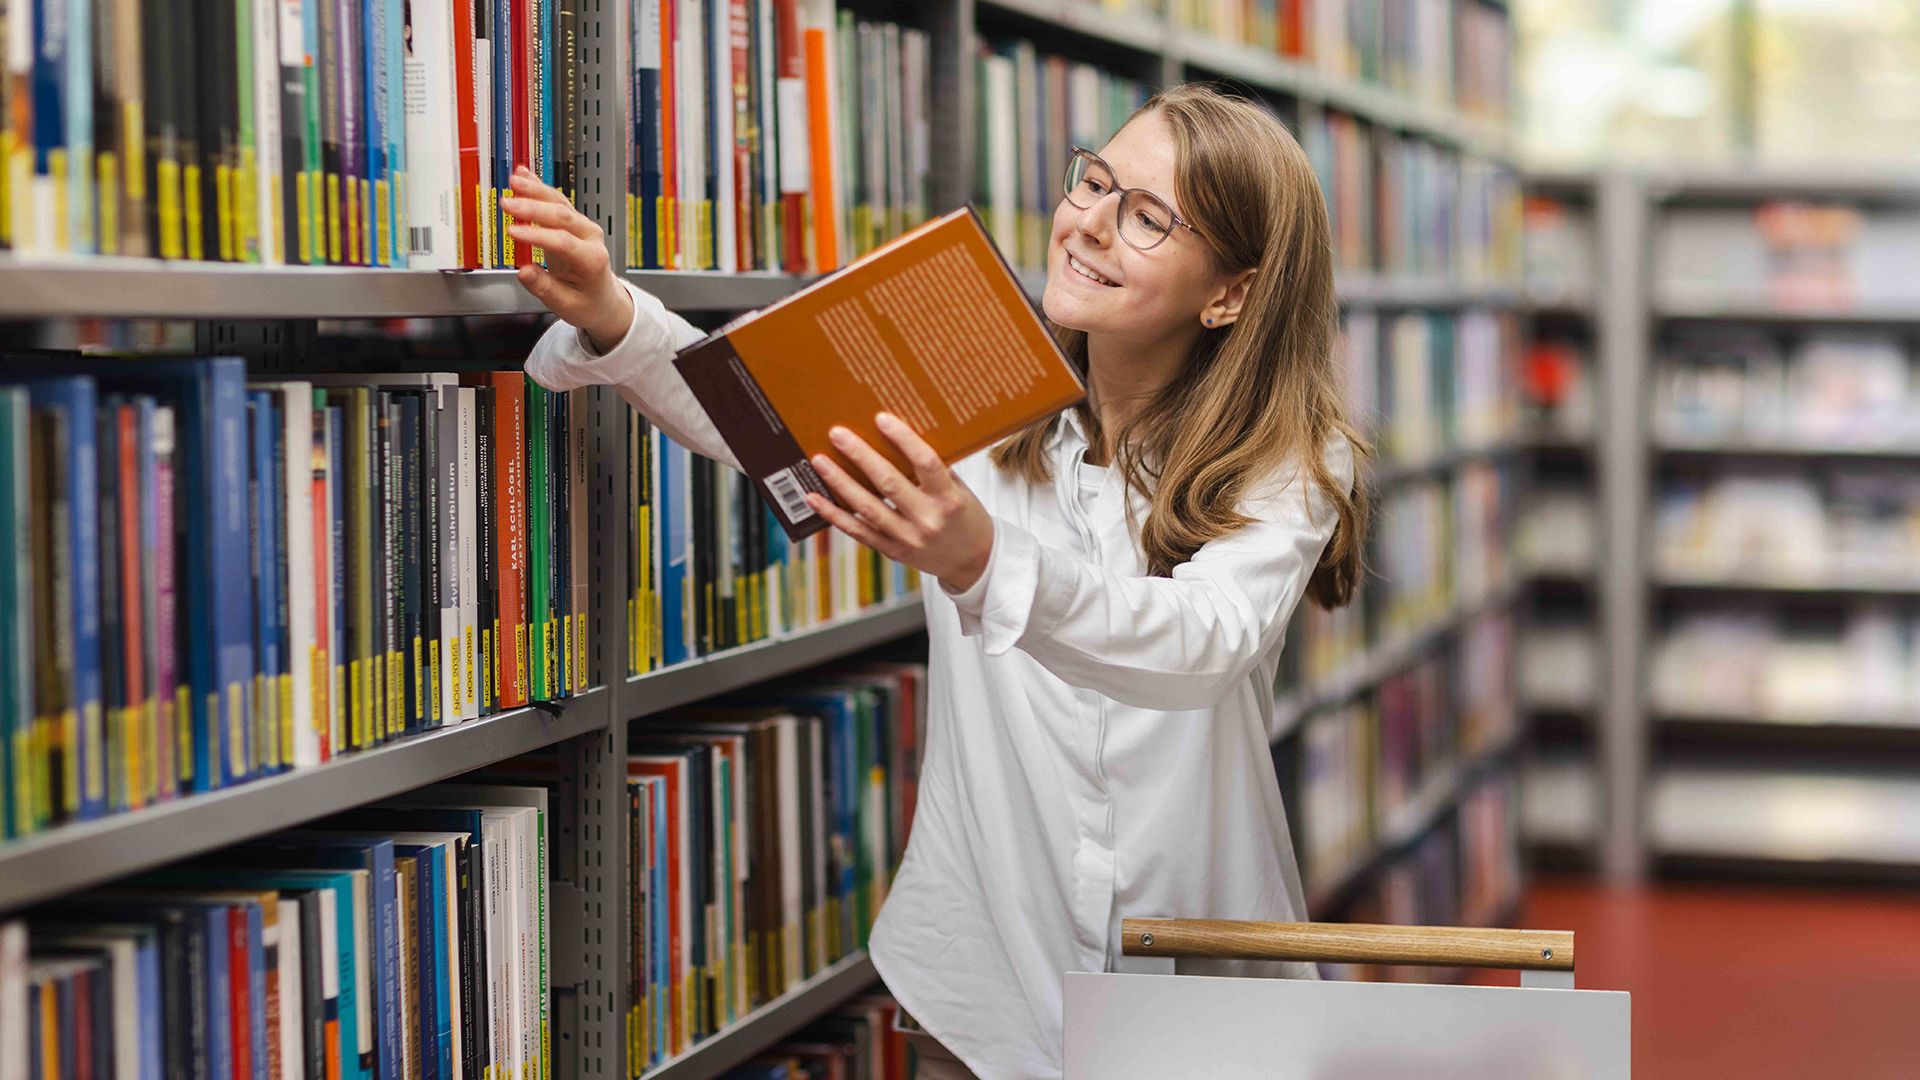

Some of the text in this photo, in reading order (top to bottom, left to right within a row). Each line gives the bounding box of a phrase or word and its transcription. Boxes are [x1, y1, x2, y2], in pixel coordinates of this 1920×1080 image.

[470, 0, 478, 123] Personalmanageme
[514, 397, 522, 497] JAHRHUNDERT
[448, 462, 459, 608] Mythos Ruhrbistum
[508, 459, 518, 570] KARL SCHLÖGEL
[516, 501, 526, 598] SOWJETISCHE
[450, 642, 458, 677] 20355
